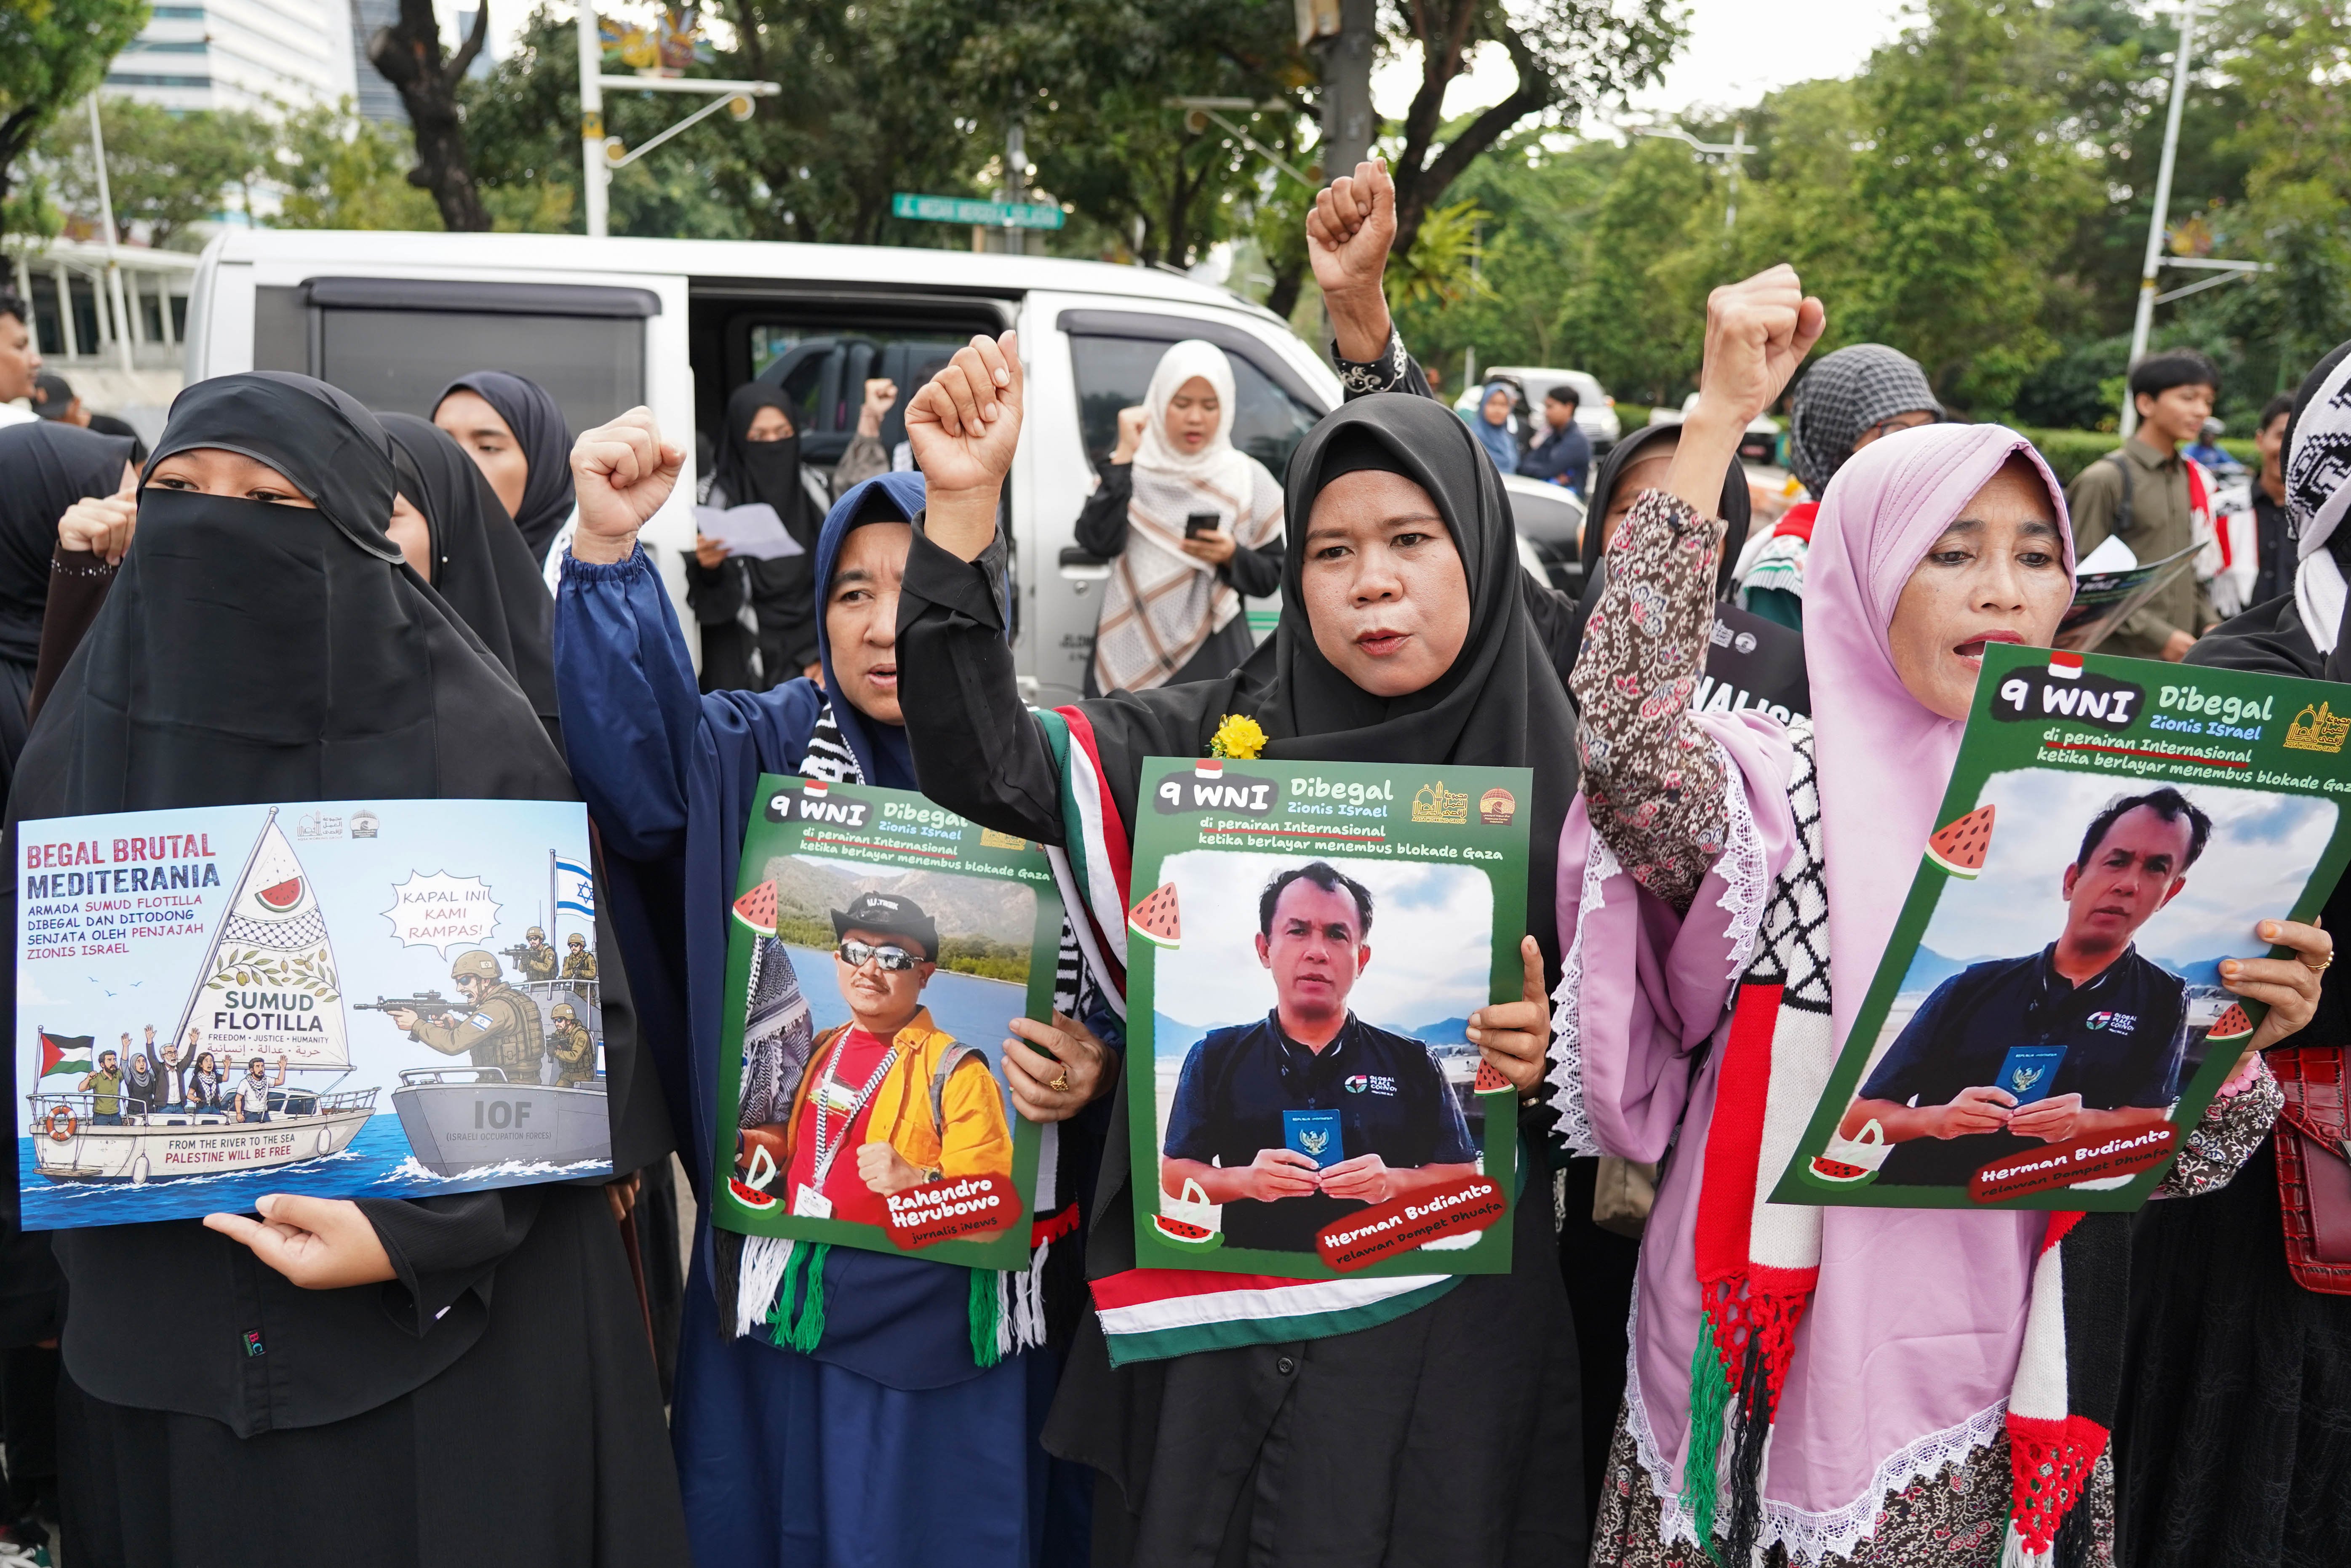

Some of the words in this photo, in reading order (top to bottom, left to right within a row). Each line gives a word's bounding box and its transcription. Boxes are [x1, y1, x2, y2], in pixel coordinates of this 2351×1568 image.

[2001, 680, 2028, 711] 9
[2043, 684, 2135, 723] WNI
[2159, 685, 2273, 724] Dibegal
[2150, 715, 2202, 733] Zionis
[2206, 721, 2261, 741] Israel
[2043, 727, 2060, 742] di
[2063, 731, 2136, 750] perairan
[2140, 739, 2251, 763] Internasional
[2037, 747, 2090, 765] ketika
[2094, 754, 2166, 773] berlayar
[2170, 763, 2253, 782] menembus
[2257, 771, 2319, 789] blokade
[2323, 779, 2351, 792] Gaz
[1159, 781, 1180, 805] 9
[1194, 784, 1270, 810] WNI
[1291, 778, 1393, 805] Dibegal
[771, 795, 788, 817] 9
[799, 799, 866, 827] WNI
[1288, 801, 1333, 816] Zionis
[1338, 803, 1388, 817] Israel
[879, 821, 916, 835] Zionis
[920, 826, 962, 841] Israel
[1200, 817, 1214, 829] di
[1218, 818, 1280, 833] perairan
[1284, 821, 1386, 837] Internasional
[27, 841, 105, 869] BEGAL
[113, 833, 216, 862] BRUTAL
[803, 827, 815, 838] di
[817, 831, 870, 845] perairan
[873, 837, 958, 856] Internasional
[1198, 832, 1244, 846] ketika
[1247, 834, 1310, 853] berlayar
[1315, 839, 1393, 855] menembus
[1397, 843, 1457, 858] blokade
[1462, 846, 1503, 860] Gaza
[800, 841, 838, 855] ketika
[841, 845, 895, 863] berlayar
[897, 855, 961, 870] menembus
[965, 861, 1014, 877] blokade
[1018, 869, 1050, 881] Gaza
[27, 863, 220, 899] MEDITERANIA
[28, 903, 79, 916] ARMADA
[85, 900, 131, 912] SUMUD
[138, 895, 202, 908] FLOTILLA
[403, 891, 459, 903] KAPAL
[466, 890, 486, 901] INI
[28, 917, 80, 931] DIBEGAL
[86, 915, 113, 926] DAN
[120, 910, 194, 924] DITODONG
[425, 908, 467, 920] KAMI
[28, 931, 86, 945] SENJATA
[92, 929, 126, 941] OLEH
[132, 923, 204, 938] PENJAJAH
[409, 925, 483, 939] RAMPAS!
[27, 947, 76, 960] ZIONIS
[81, 943, 129, 955] ISRAEL
[225, 991, 314, 1011] SUMUD
[214, 1013, 323, 1032] FLOTILLA
[208, 1034, 246, 1042] FREEDOM
[254, 1034, 283, 1043] JUSTICE
[292, 1035, 329, 1044] HUMANITY
[208, 1043, 246, 1056] إنسانية
[258, 1044, 284, 1056] عدالة
[296, 1047, 320, 1057] حرية
[475, 1101, 532, 1129] IOF
[169, 1140, 196, 1150] FROM
[200, 1139, 216, 1149] THE
[221, 1137, 246, 1148] RIVER
[250, 1136, 260, 1146] TO
[263, 1136, 278, 1145] THE
[281, 1134, 295, 1144] SEA
[446, 1132, 478, 1142] (ISRAELI
[480, 1132, 523, 1141] OCCUPATION
[526, 1131, 551, 1140] FORCES)
[165, 1151, 224, 1164] PALESTINE
[228, 1149, 251, 1160] WILL
[255, 1148, 266, 1158] BE
[270, 1145, 291, 1157] FREE
[1981, 1156, 2068, 1182] Herman
[2074, 1130, 2170, 1160] Budianto
[1982, 1176, 2047, 1197] relawan
[2052, 1162, 2109, 1181] Dompet
[2115, 1148, 2169, 1166] Dhuafa
[886, 1179, 993, 1212] Rahendro
[891, 1195, 1000, 1228] Herubowo
[1324, 1216, 1403, 1248] Herman
[1405, 1184, 1492, 1220] Budianto
[912, 1226, 958, 1244] jurnalis
[960, 1217, 998, 1232] iNews
[1336, 1239, 1395, 1264] relawan
[1397, 1219, 1449, 1243] Dompet
[1451, 1202, 1503, 1223] Dhuafa
